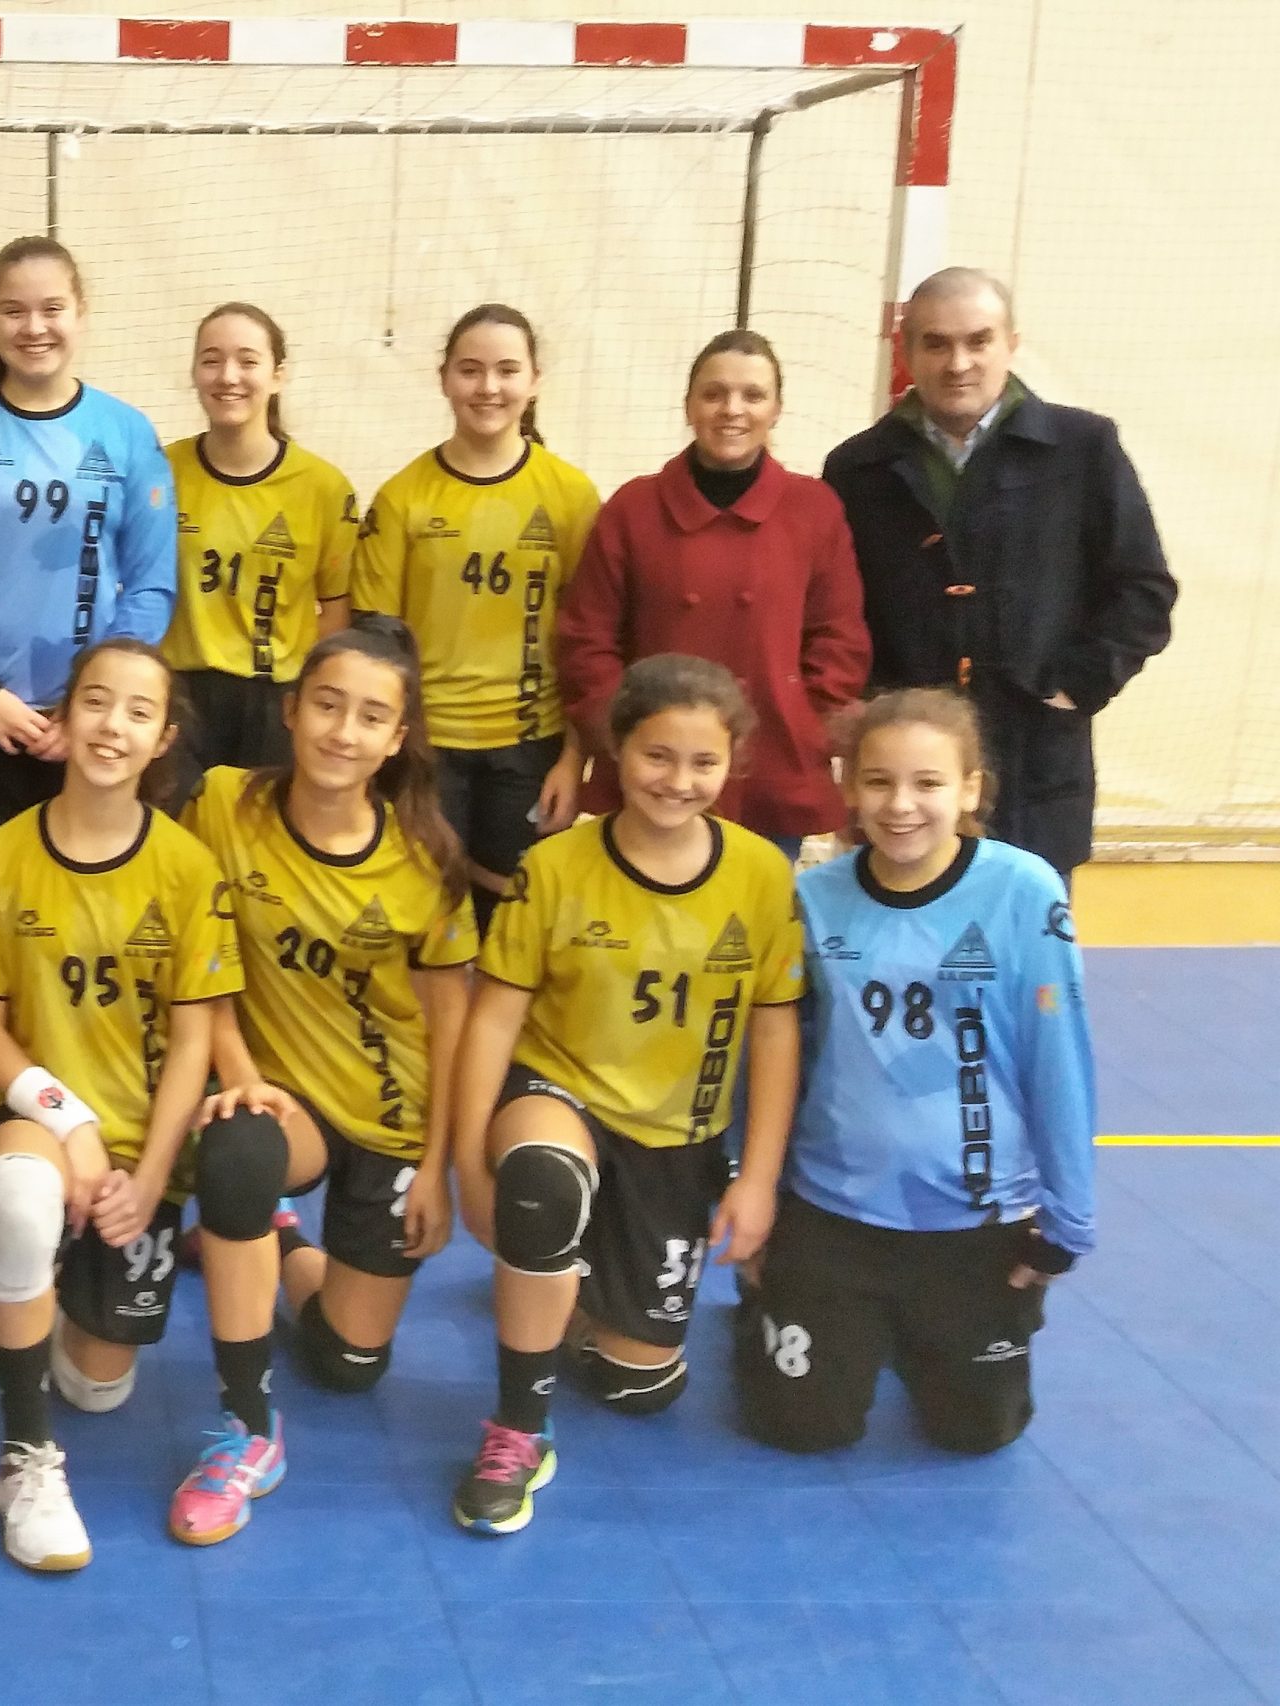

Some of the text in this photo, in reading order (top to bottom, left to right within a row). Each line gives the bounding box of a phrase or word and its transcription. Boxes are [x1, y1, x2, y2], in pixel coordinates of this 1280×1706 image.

[16, 478, 69, 524] 99
[200, 549, 242, 596] 31
[461, 551, 511, 595] 46
[275, 926, 337, 979] 20
[61, 955, 120, 1007] 95
[631, 969, 690, 1029] 51
[861, 980, 935, 1040] 98
[123, 1227, 175, 1282] 95
[656, 1238, 707, 1290] 51
